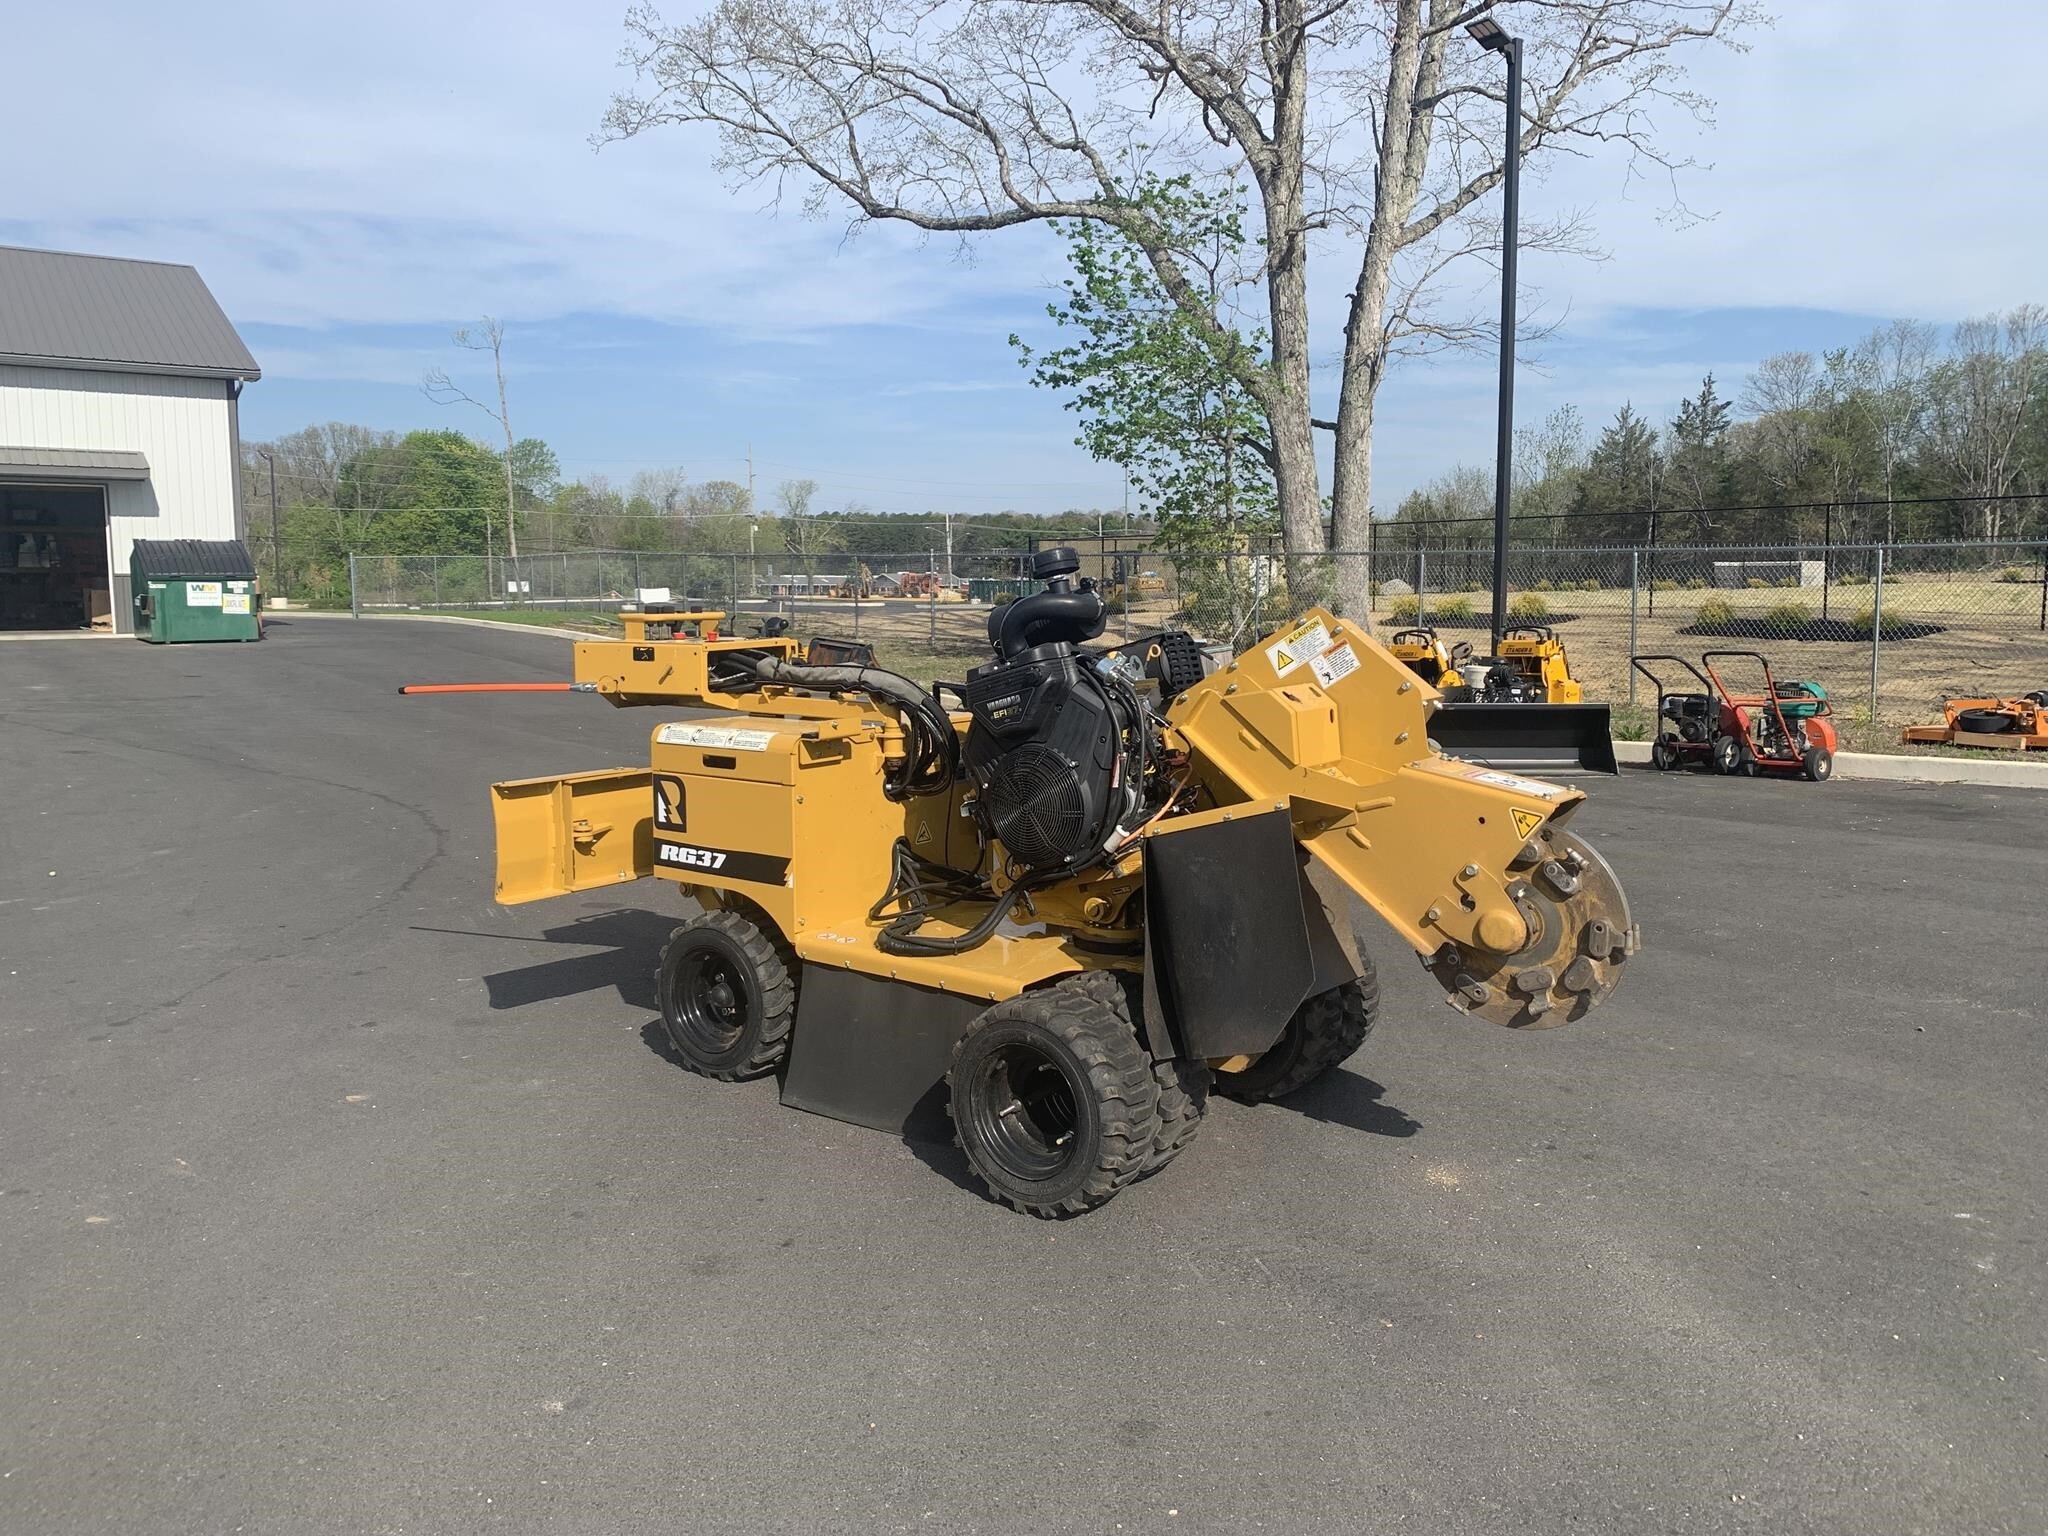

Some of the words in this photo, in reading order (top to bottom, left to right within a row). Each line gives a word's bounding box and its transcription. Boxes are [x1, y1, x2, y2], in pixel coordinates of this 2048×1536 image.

[1293, 619, 1320, 640] CAUTION
[993, 708, 1008, 719] EFI
[660, 844, 727, 869] RG37
